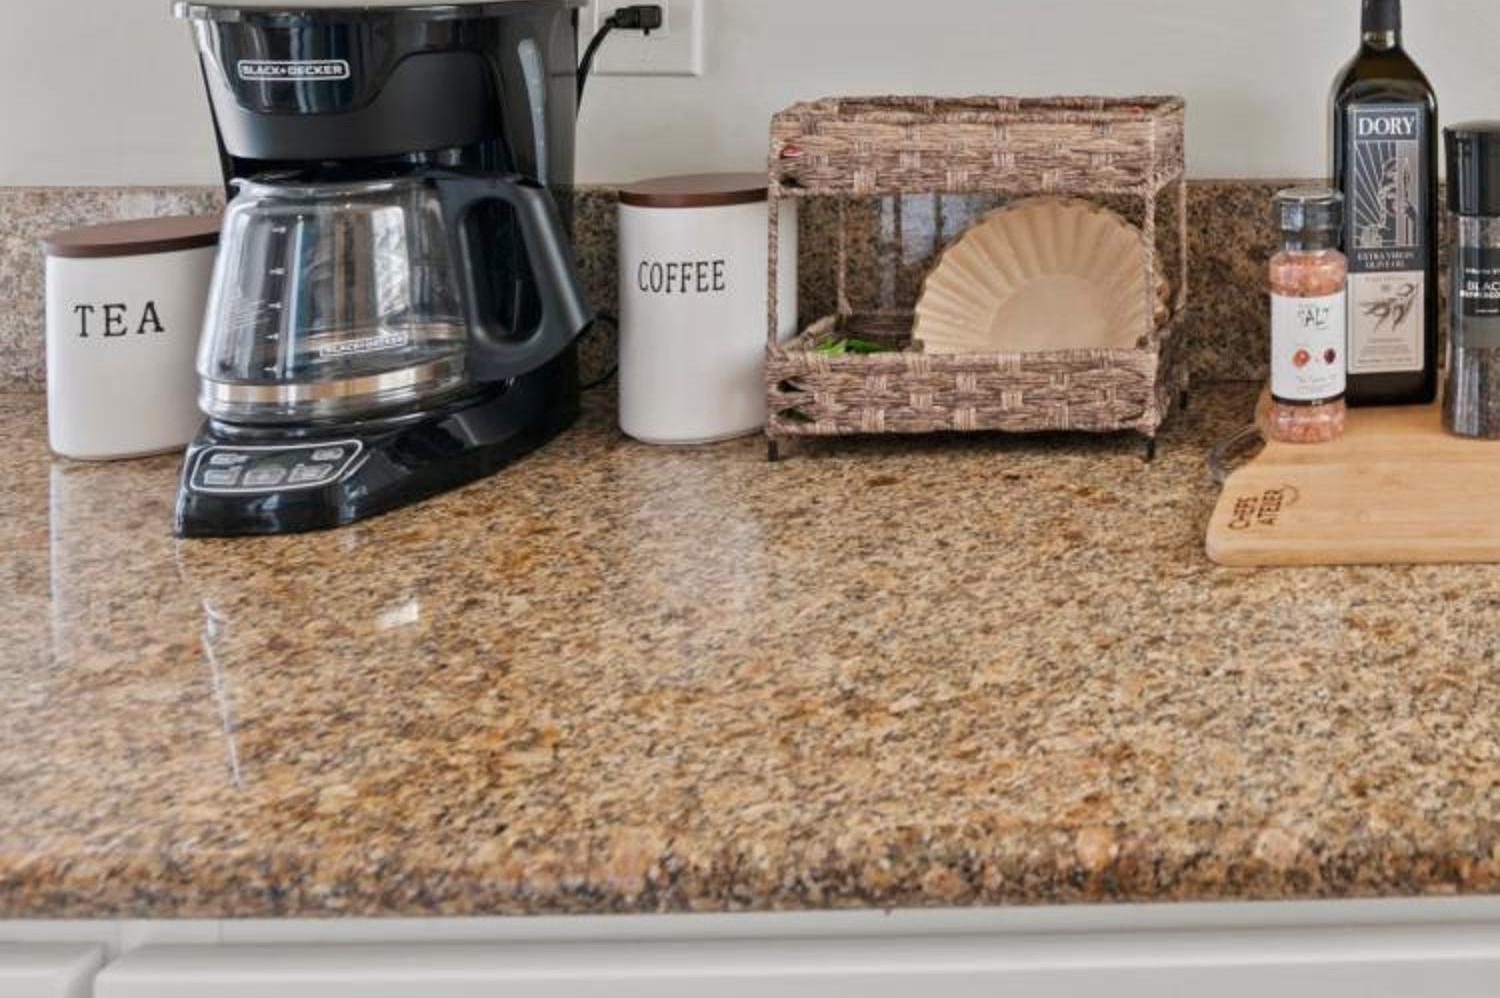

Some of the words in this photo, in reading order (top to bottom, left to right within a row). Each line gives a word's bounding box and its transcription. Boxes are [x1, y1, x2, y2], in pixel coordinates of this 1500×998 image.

[1357, 117, 1415, 135] DORY
[637, 259, 726, 293] COFFEE
[73, 300, 165, 338] TEA
